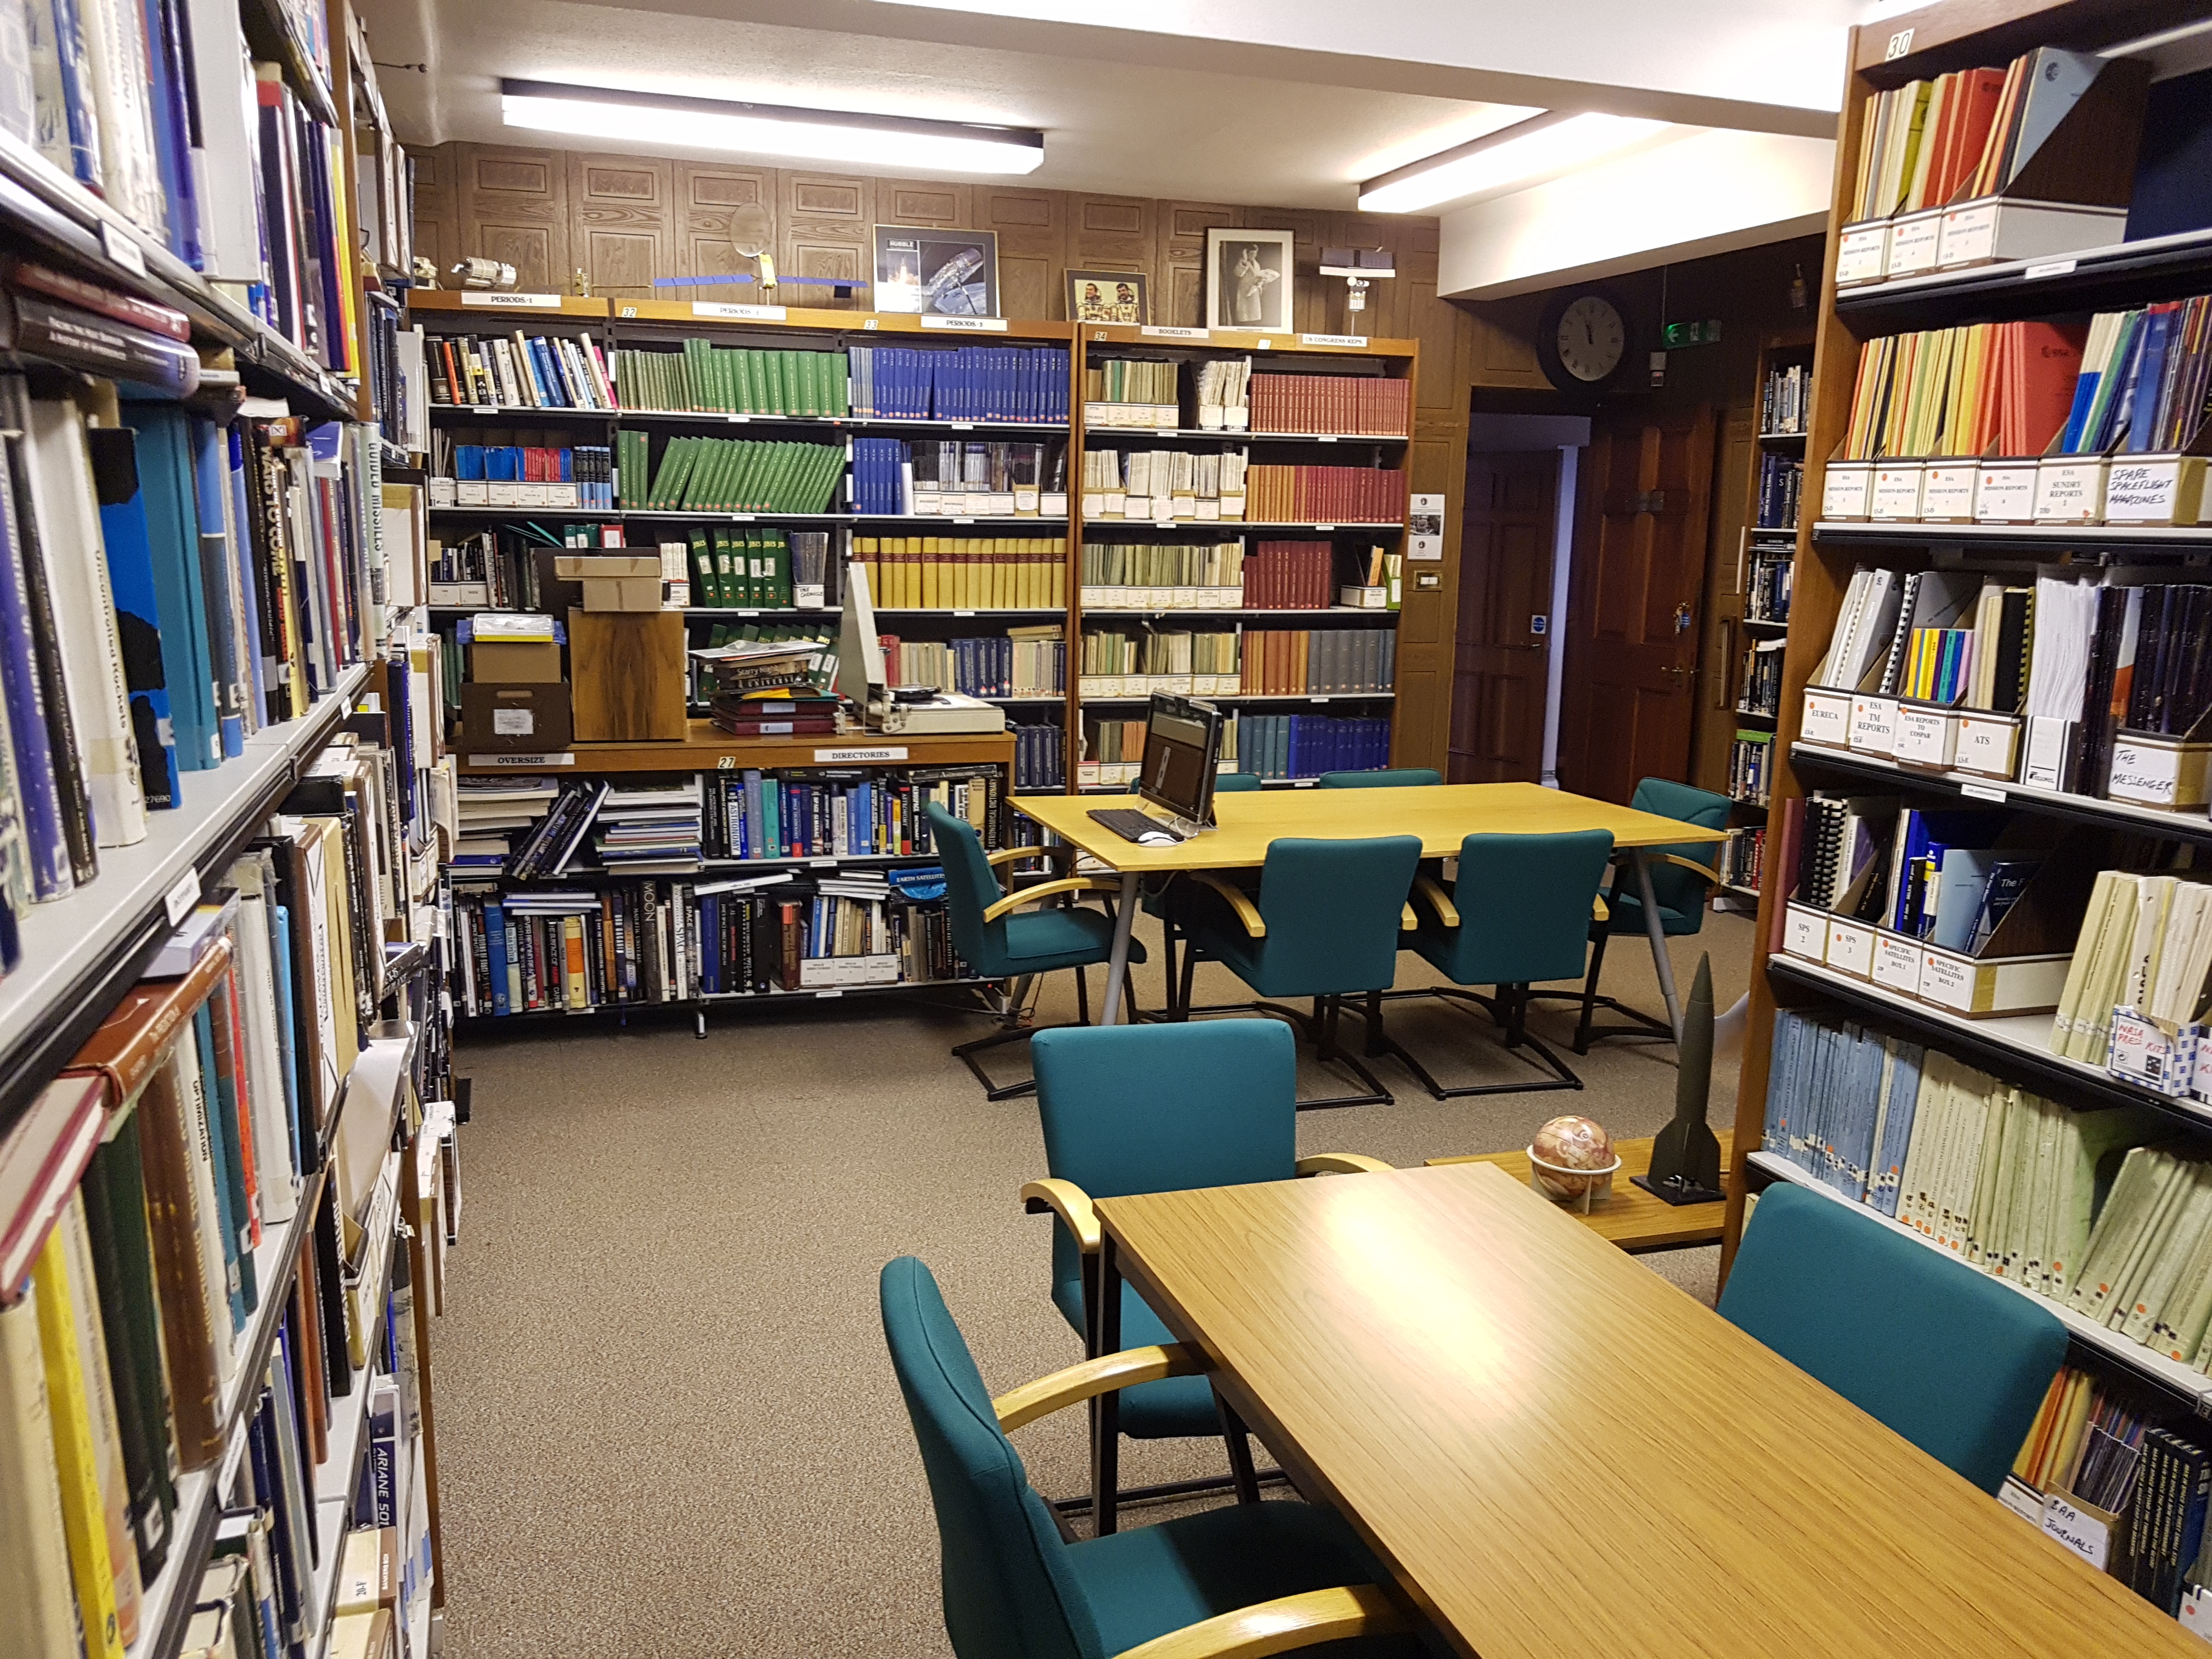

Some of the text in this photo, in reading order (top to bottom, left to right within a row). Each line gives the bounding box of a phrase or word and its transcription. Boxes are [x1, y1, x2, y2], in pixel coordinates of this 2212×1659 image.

[1888, 32, 1910, 59] 30
[623, 308, 635, 317] 32
[865, 321, 877, 329] 33
[2112, 468, 2151, 481] SPARE
[2109, 479, 2174, 490] SPACEFLIGHT
[368, 443, 384, 552] GUIDED MISSILES
[2108, 494, 2166, 506] MAGAZINES
[261, 446, 282, 576] WARS TO COME
[737, 668, 759, 676] Starry
[111, 662, 128, 729] Rockets
[1869, 702, 1882, 710] ESA
[1812, 709, 1838, 720] EURECA
[1869, 713, 1881, 722] TM
[1915, 716, 1940, 725] REPORTS
[1857, 721, 1891, 734] REPORTS
[1910, 730, 1931, 739] COSPAR
[1974, 736, 1991, 745] ATS
[832, 751, 890, 759] DIRECTORIES
[2115, 749, 2136, 764] THE
[719, 757, 735, 768] 27
[2111, 773, 2173, 795] MESSENGER
[144, 794, 171, 804] 27690
[988, 778, 998, 848] ASTRONOMICAL DICTIONARY
[729, 804, 740, 851] ASTRONOMY
[2001, 878, 2017, 887] The
[643, 882, 656, 922] MOON
[633, 908, 642, 934] MAJESTIC
[1798, 923, 1810, 933] SPS
[478, 934, 487, 952] VISIONS
[675, 927, 685, 956] SPACE
[1845, 934, 1857, 945] SPS
[1888, 944, 1912, 955] SPECIFIC
[552, 957, 558, 966] OF
[1884, 950, 1915, 963] SATELLITES
[480, 959, 489, 972] SPACE
[1891, 961, 1903, 969] BOX
[1936, 960, 1961, 973] SPECIFIC
[1931, 966, 1964, 981] SATELLITES
[1938, 977, 1951, 985] BOX
[2119, 1024, 2143, 1039] NASA
[193, 1080, 209, 1162] OPTIMIZATION
[2148, 1468, 2157, 1487] SPACE
[2158, 1474, 2167, 1494] SPACE
[376, 1447, 390, 1526] ARIANE 501
[2168, 1479, 2177, 1498] SPACE
[2144, 1486, 2154, 1509] BEYOND
[2179, 1484, 2187, 1503] SPACE
[2051, 1500, 2076, 1521] BAA
[2142, 1510, 2151, 1521] THE
[2165, 1503, 2173, 1515] NEW
[2045, 1517, 2095, 1555] JOURNALS
[2151, 1525, 2160, 1537] AND
[2172, 1531, 2180, 1550] SMALL
